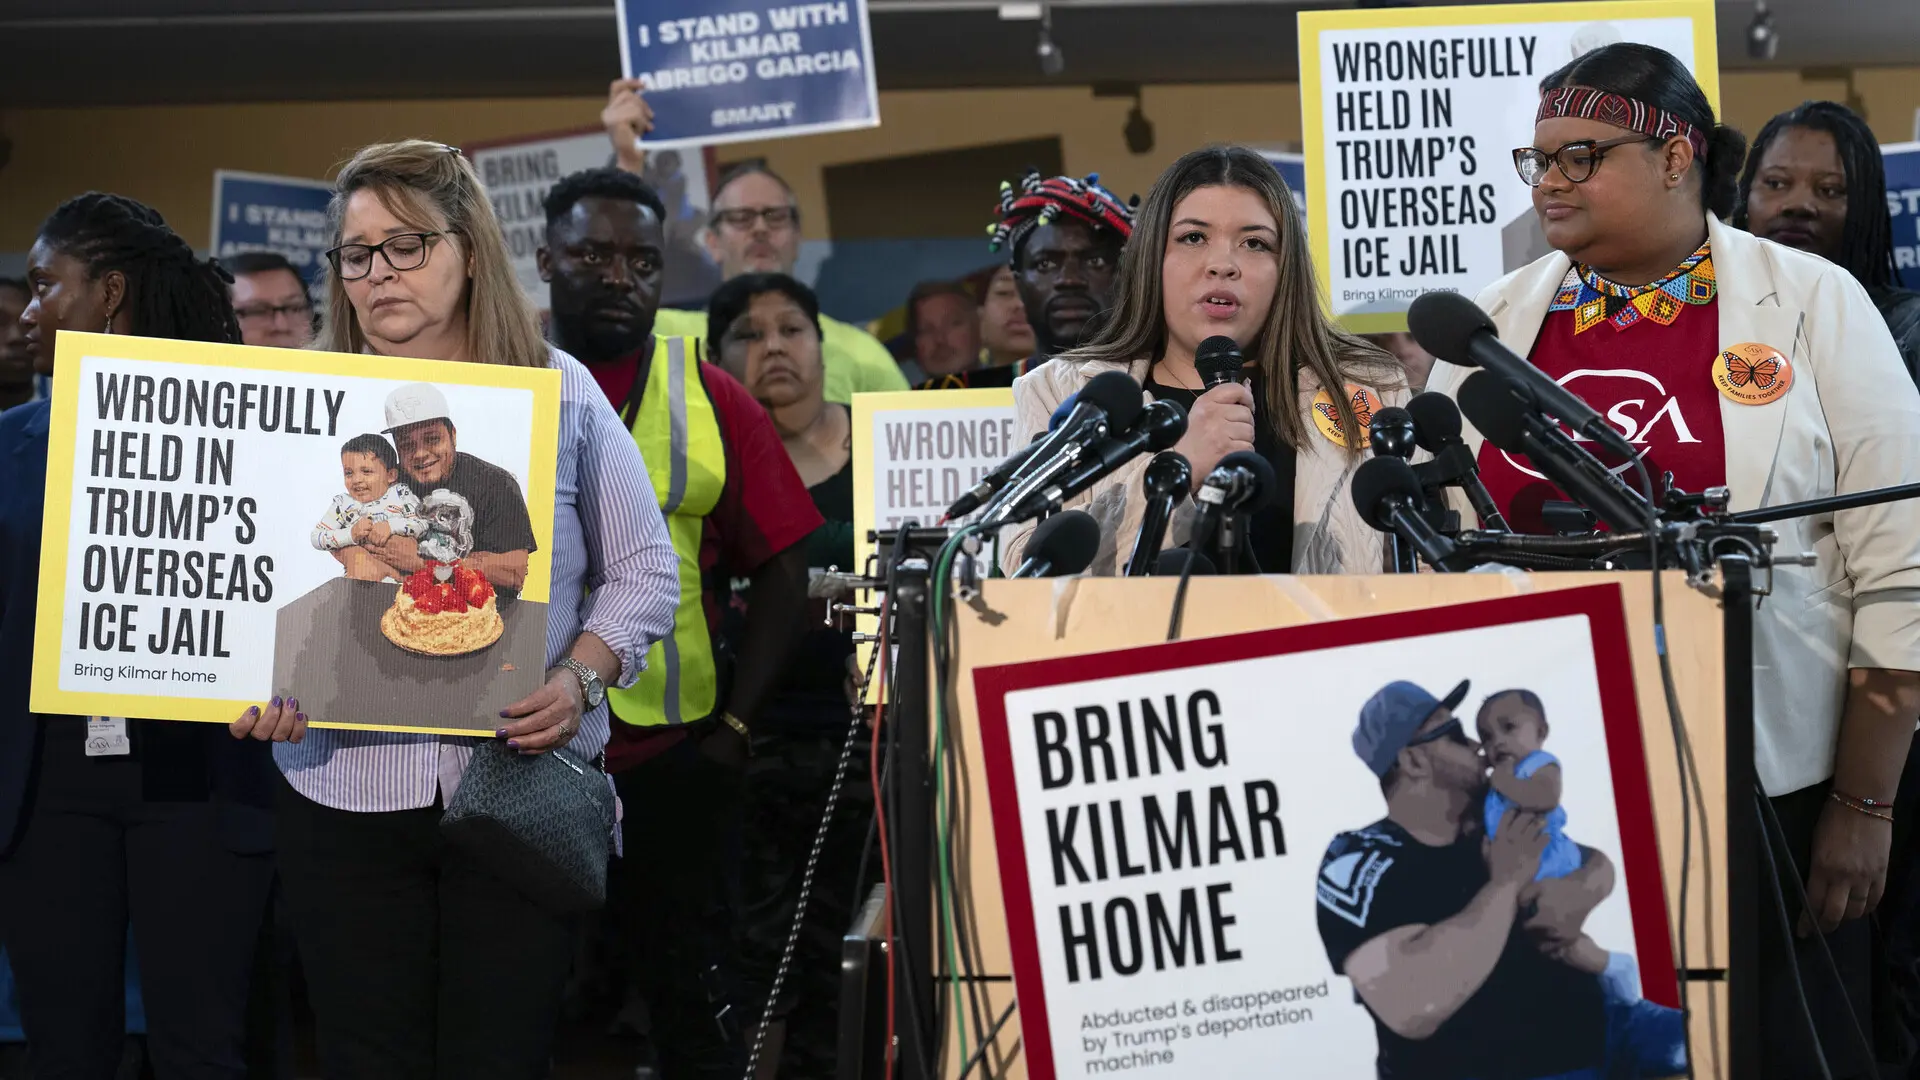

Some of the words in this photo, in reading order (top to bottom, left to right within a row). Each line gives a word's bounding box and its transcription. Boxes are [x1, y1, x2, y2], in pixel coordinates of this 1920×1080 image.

[638, 24, 650, 47] I
[658, 11, 760, 44] STAND
[767, 2, 849, 31] WITH
[639, 60, 749, 92] ABREGO
[755, 48, 862, 80] GARCIA
[690, 32, 802, 64] KILMAR
[1332, 36, 1537, 83] WRONGFULLY
[711, 101, 797, 127] SMART
[1336, 89, 1411, 132] HELD
[1421, 87, 1453, 129] IN
[483, 148, 560, 188] BRING
[1336, 135, 1478, 181] TRUMP’S
[1340, 183, 1497, 230] OVERSEAS
[1343, 236, 1391, 279] ICE
[1399, 233, 1468, 277] JAIL
[1343, 289, 1376, 304] Bring
[1379, 287, 1419, 300] Kilmar
[1744, 345, 1763, 356] CASA
[96, 371, 346, 437] WRONGFULLY
[1717, 374, 1729, 389] KEEP
[1726, 386, 1757, 400] FAMILIES
[1758, 379, 1786, 400] TOGETHER
[885, 418, 1014, 461] WRONGF
[1326, 426, 1342, 440] KEEP
[90, 429, 183, 482] HELD
[195, 436, 234, 486] IN
[887, 467, 960, 509] HELD
[86, 486, 257, 545] TRUMP’S
[82, 544, 274, 603] OVERSEAS
[78, 602, 139, 653] ICE
[147, 606, 231, 658] JAIL
[74, 663, 114, 681] Bring
[118, 665, 168, 680] Kilmar
[171, 668, 217, 683] home
[1033, 689, 1228, 791] BRING
[1045, 779, 1287, 887] KILMAR
[1058, 882, 1243, 984] HOME
[1081, 1002, 1178, 1030] Abducted
[1182, 999, 1197, 1017] &
[1203, 980, 1329, 1014] disappeared
[1083, 1035, 1107, 1055] by
[1113, 1024, 1192, 1047] Trump's
[1197, 1007, 1313, 1038] deportation
[1086, 1048, 1175, 1075] machine
